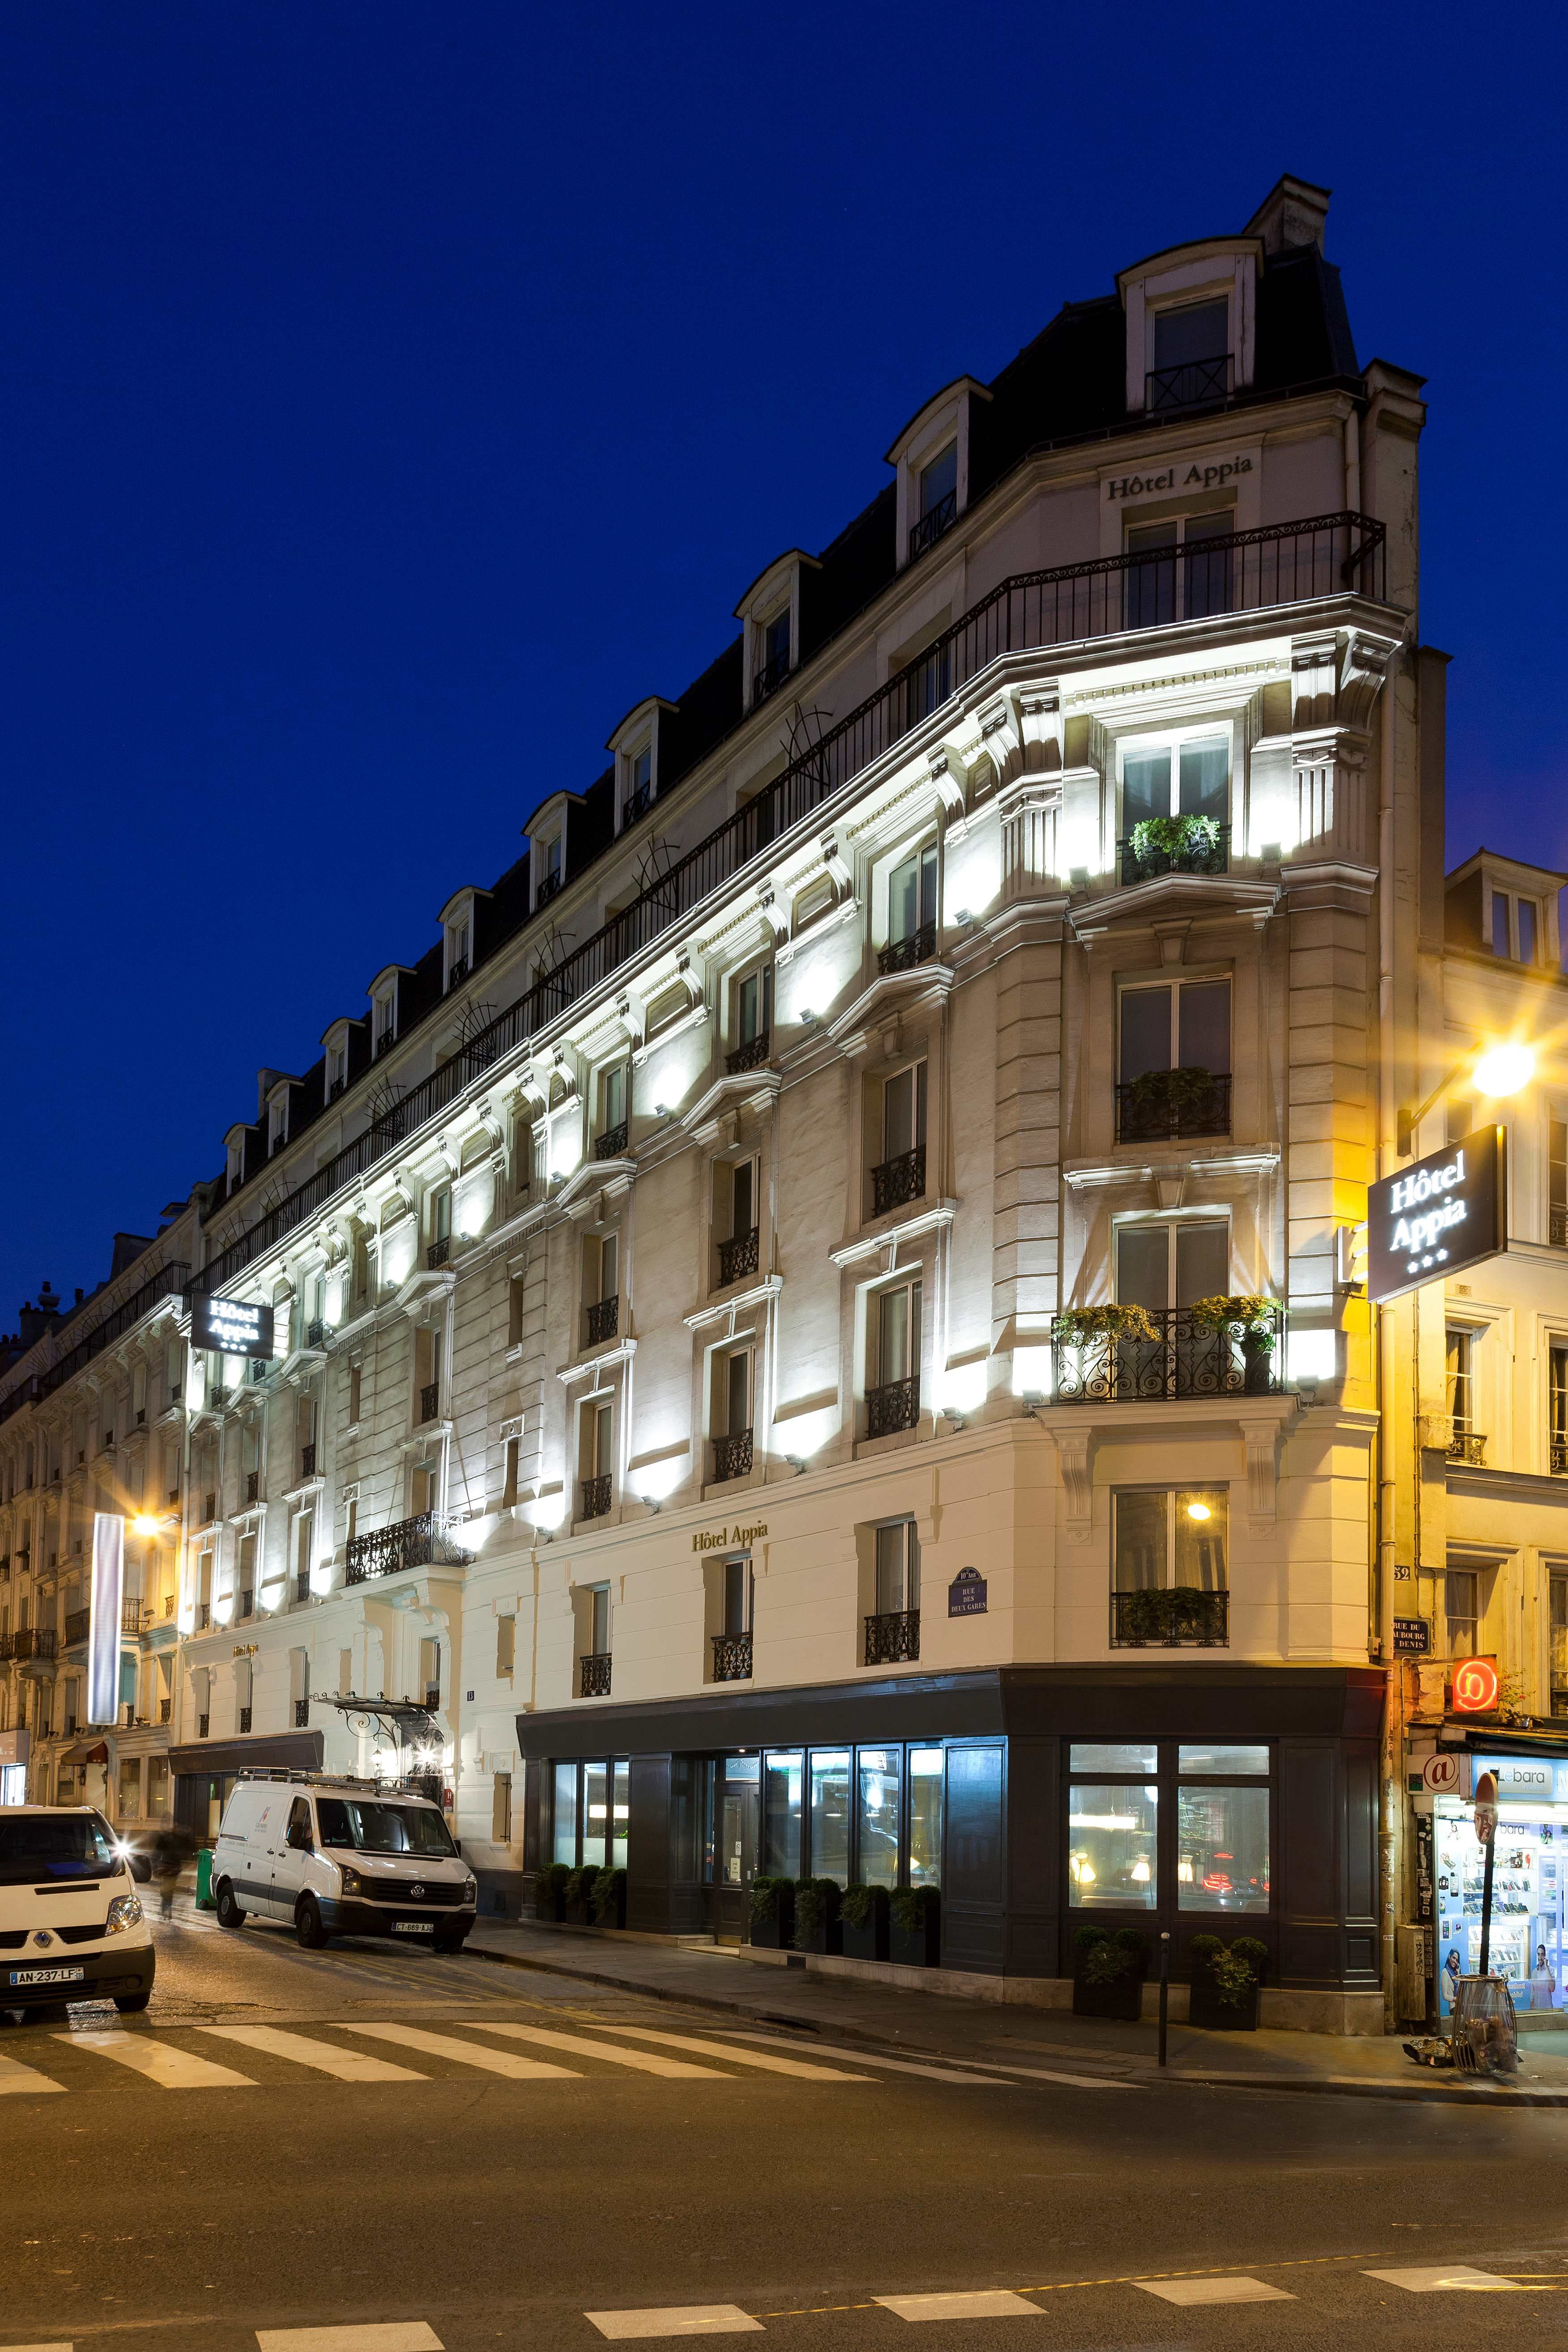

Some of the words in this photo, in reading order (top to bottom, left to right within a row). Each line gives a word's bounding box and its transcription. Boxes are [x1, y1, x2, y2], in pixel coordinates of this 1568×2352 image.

[1108, 469, 1173, 500] Hôtel
[1184, 456, 1253, 488] Appia
[1390, 1149, 1466, 1214] Hôtel
[1390, 1196, 1466, 1253] Appia
[210, 1300, 259, 1323] Hôtel
[208, 1319, 259, 1341] Appia
[691, 1527, 727, 1552] Hôtel
[731, 1520, 768, 1548] Appia
[968, 1602, 986, 1610] GARES
[1393, 1632, 1425, 1640] AUBOURG
[468, 1692, 473, 1700] 13
[1498, 1767, 1545, 1783] Lebara
[1500, 1822, 1524, 1835] bara
[19, 1969, 75, 1982] AN-237-LF
